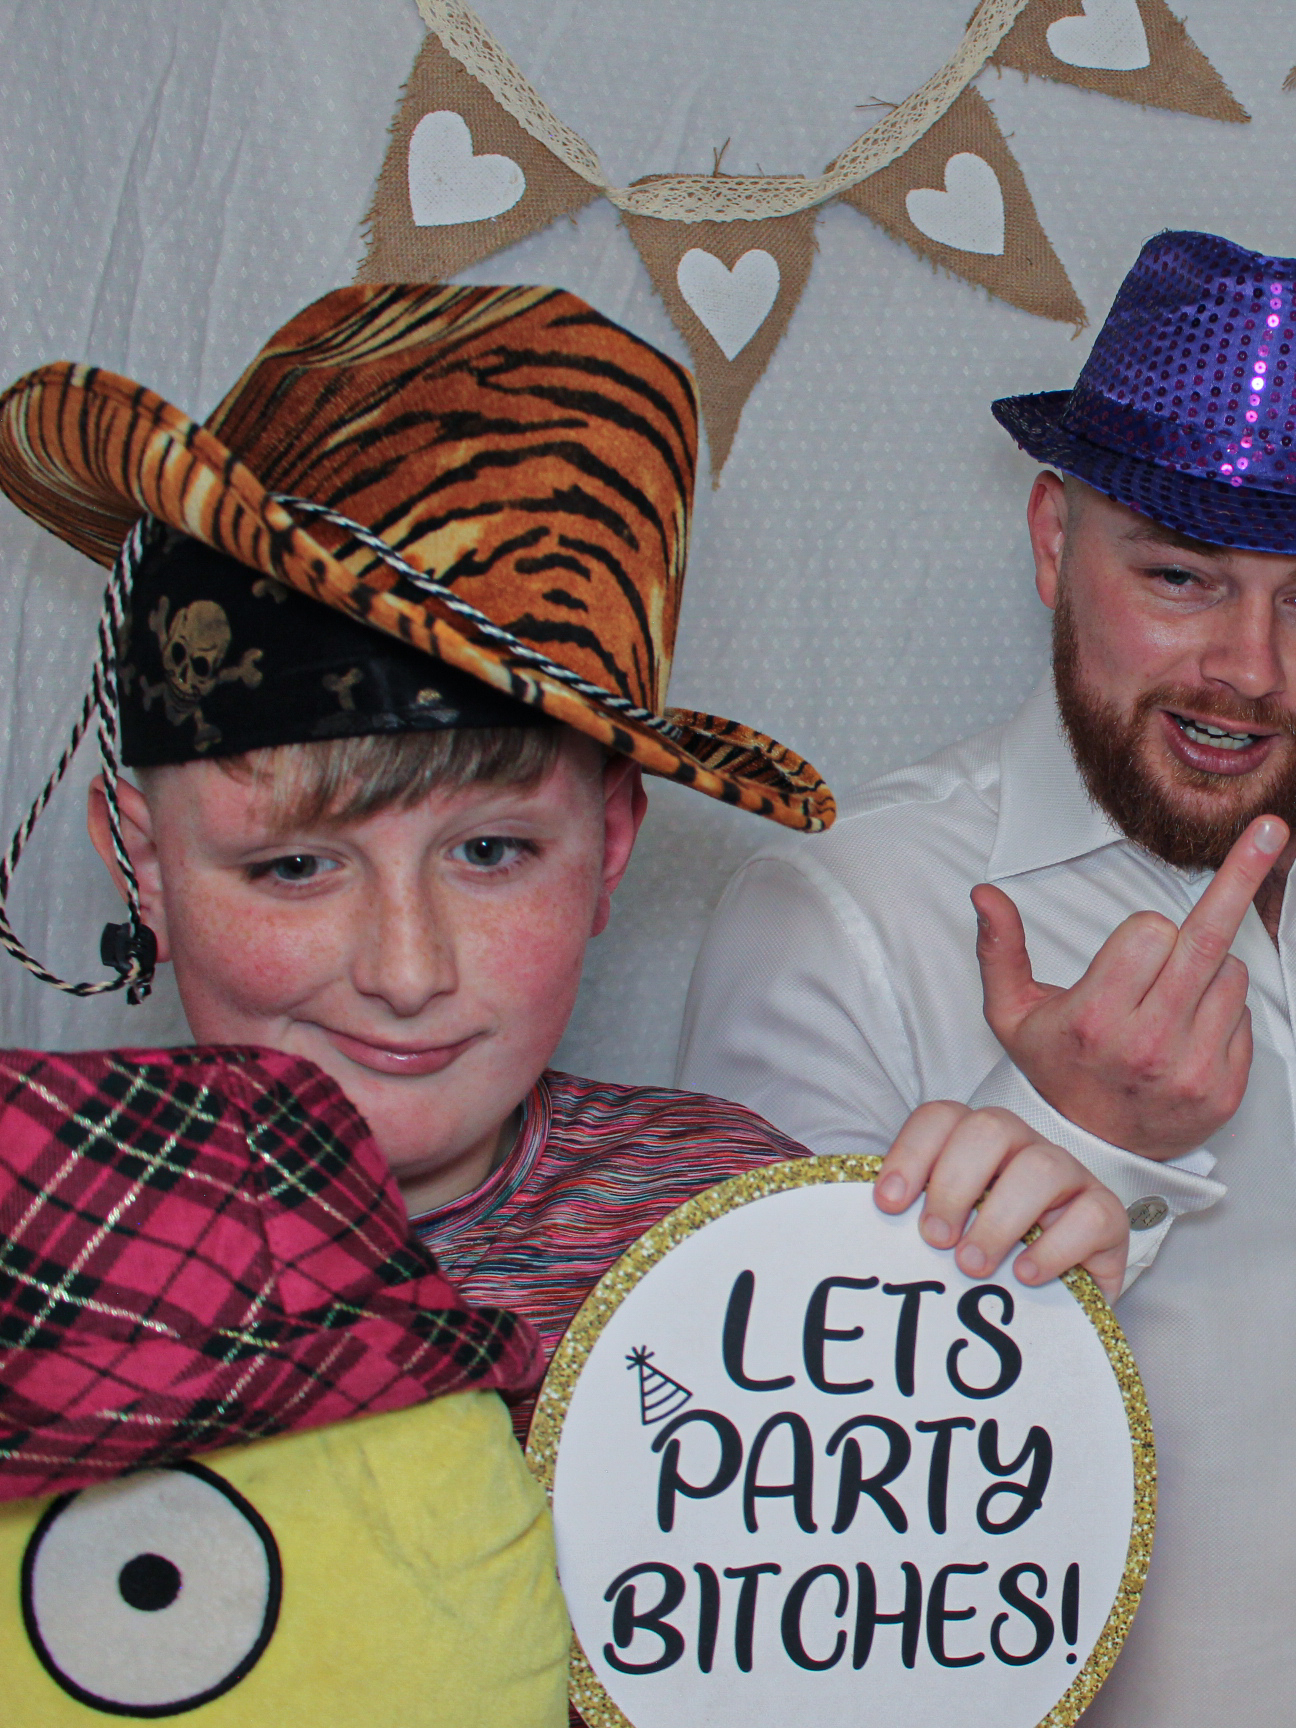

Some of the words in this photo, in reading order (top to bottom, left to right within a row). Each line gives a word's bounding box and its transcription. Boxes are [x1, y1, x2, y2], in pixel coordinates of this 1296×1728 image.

[722, 1269, 1023, 1400] LETS
[651, 1409, 1054, 1536] PARTY
[603, 1561, 1081, 1676] BITCHES!
